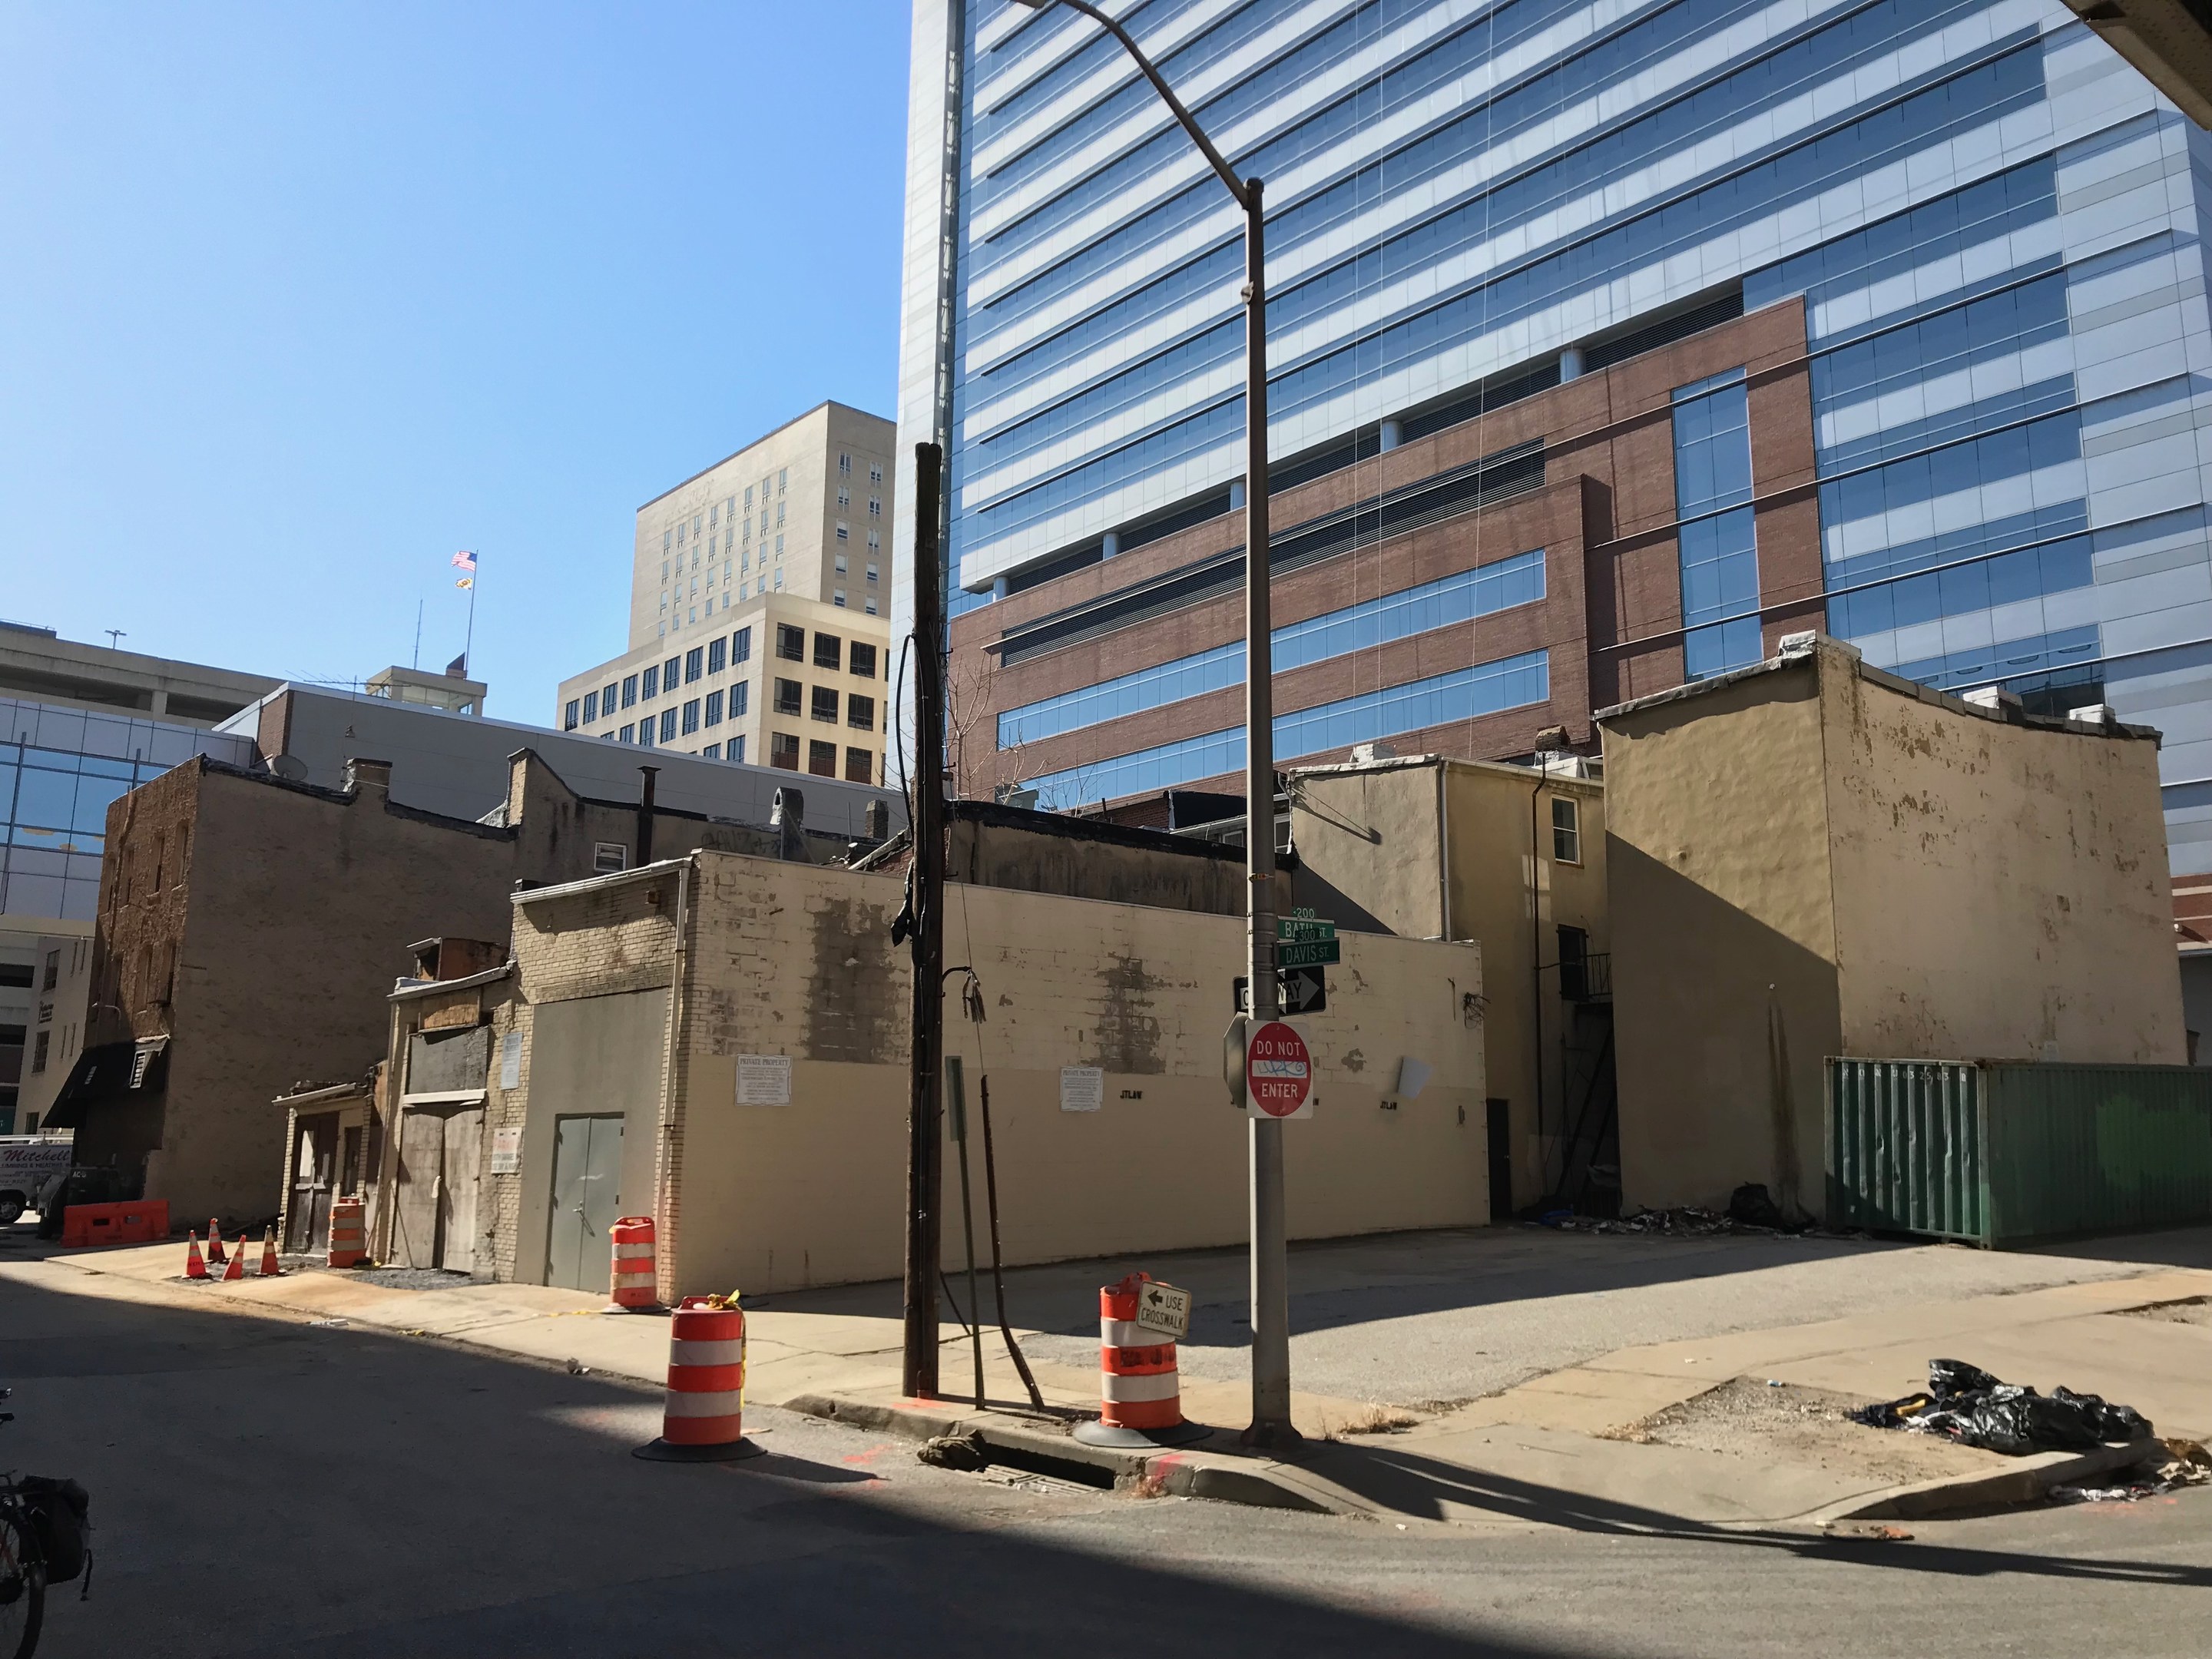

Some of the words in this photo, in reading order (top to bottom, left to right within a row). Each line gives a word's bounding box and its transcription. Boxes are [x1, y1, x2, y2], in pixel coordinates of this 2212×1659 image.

[1296, 907, 1314, 919] 200
[1299, 930, 1316, 942] 300
[1286, 945, 1317, 964] DAVIS
[1319, 946, 1330, 959] ST.
[1257, 1040, 1273, 1055] DO
[1277, 1041, 1300, 1056] NOT
[1261, 1083, 1298, 1098] ENTER
[3, 1149, 70, 1161] Mitchell
[1166, 1296, 1184, 1311] USE
[1141, 1308, 1184, 1330] CROSSWALK
